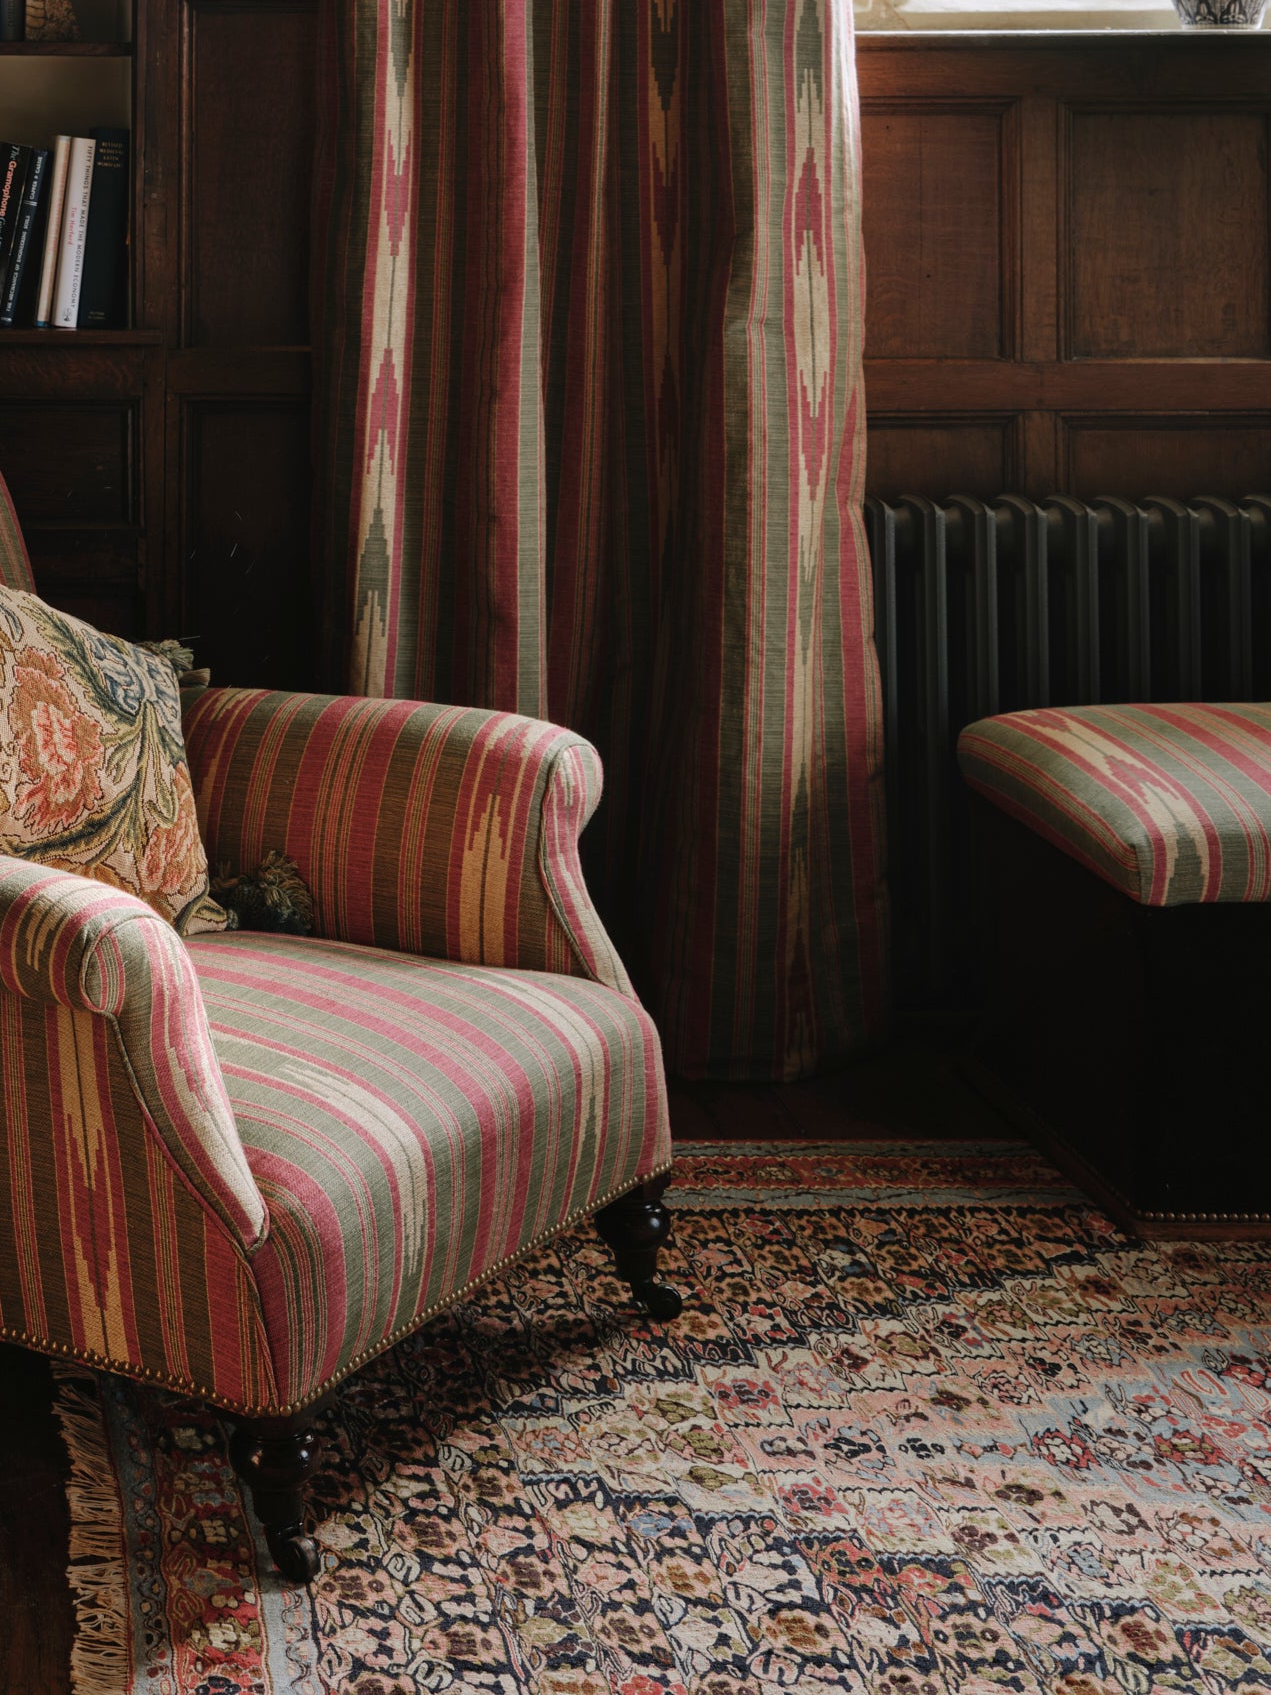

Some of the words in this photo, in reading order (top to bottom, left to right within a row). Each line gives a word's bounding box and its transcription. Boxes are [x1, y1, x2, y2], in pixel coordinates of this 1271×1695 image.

[11, 145, 20, 161] The
[0, 160, 17, 217] Gramophone
[83, 163, 91, 189] THINGS
[67, 220, 76, 245] Harford
[16, 232, 27, 262] ENGINEERING
[74, 244, 82, 272] MODERN
[14, 262, 20, 271] OF
[9, 272, 18, 300] MECHANICS
[70, 275, 80, 308] ECONOMY
